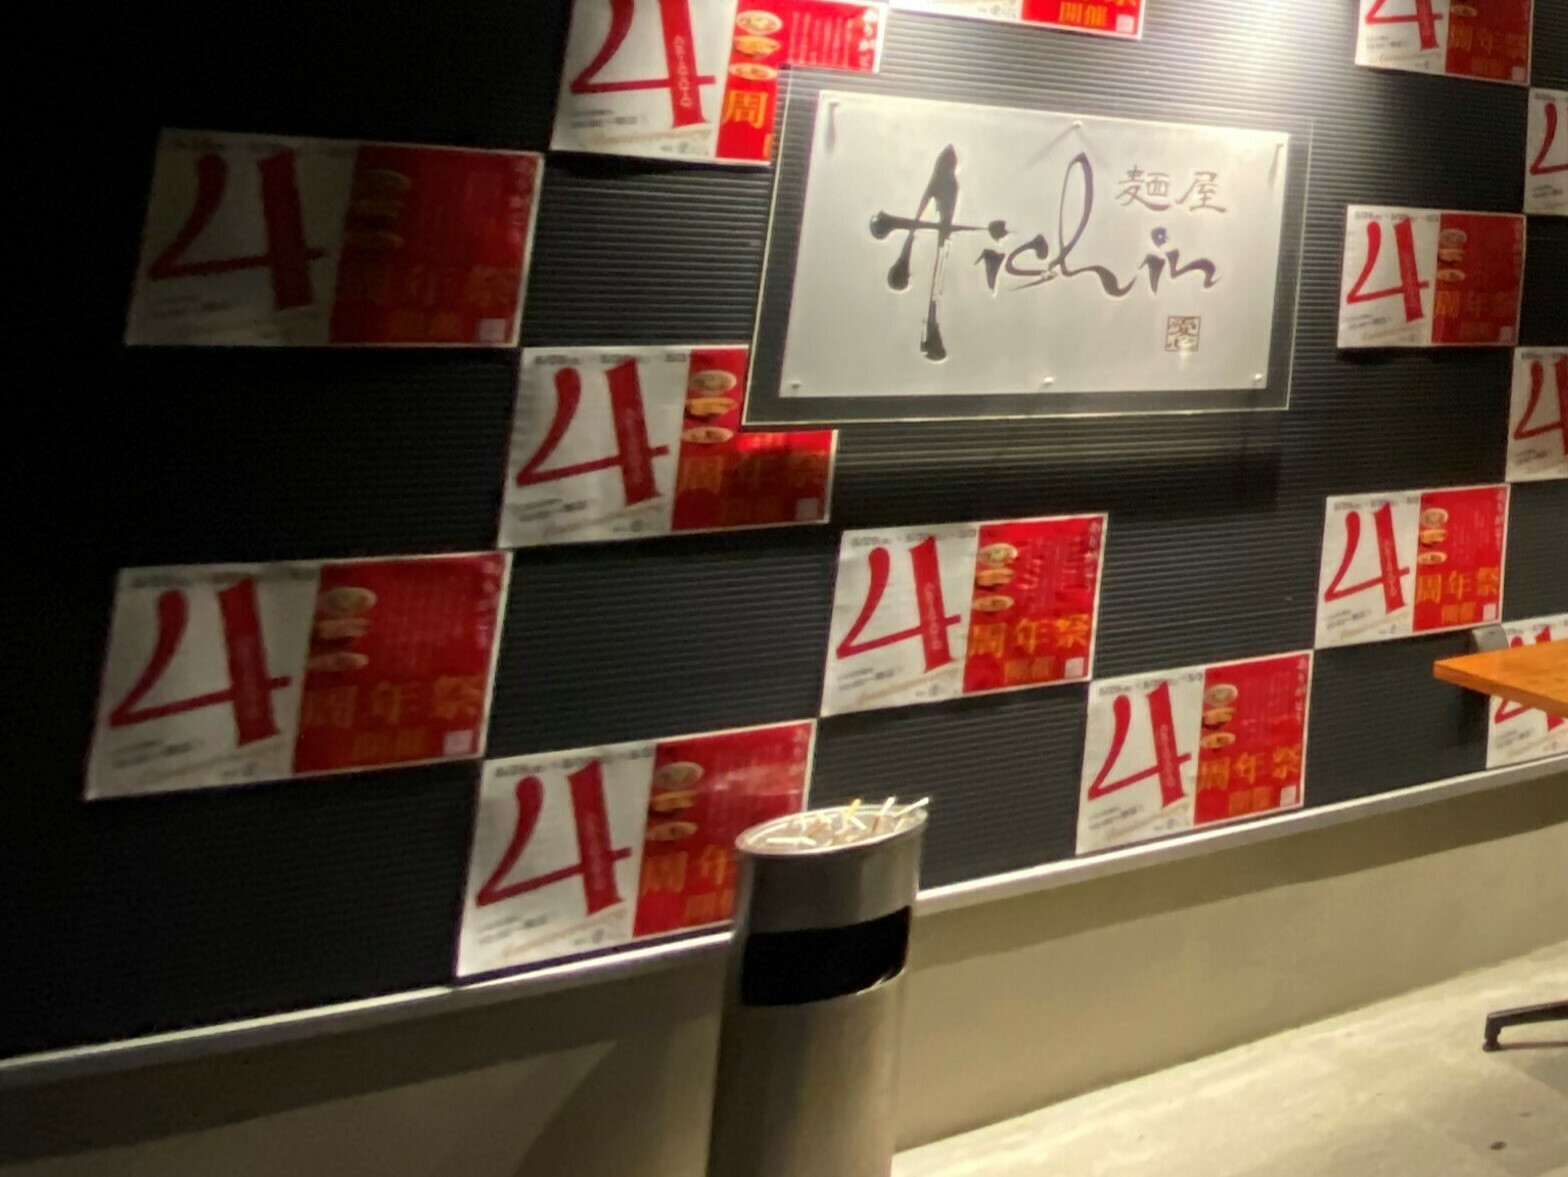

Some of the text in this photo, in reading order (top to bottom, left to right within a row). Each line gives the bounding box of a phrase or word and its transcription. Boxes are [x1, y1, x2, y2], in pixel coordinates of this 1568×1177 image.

[149, 149, 323, 309] 4
[868, 142, 1223, 362] Aishin
[1116, 163, 1229, 215] 麺屋
[1347, 218, 1428, 322] 4
[517, 358, 668, 505] 4
[837, 536, 960, 671] 4
[1325, 502, 1409, 612] 4
[109, 577, 290, 745] 4
[1088, 681, 1190, 806] 4
[477, 760, 630, 914] 4
